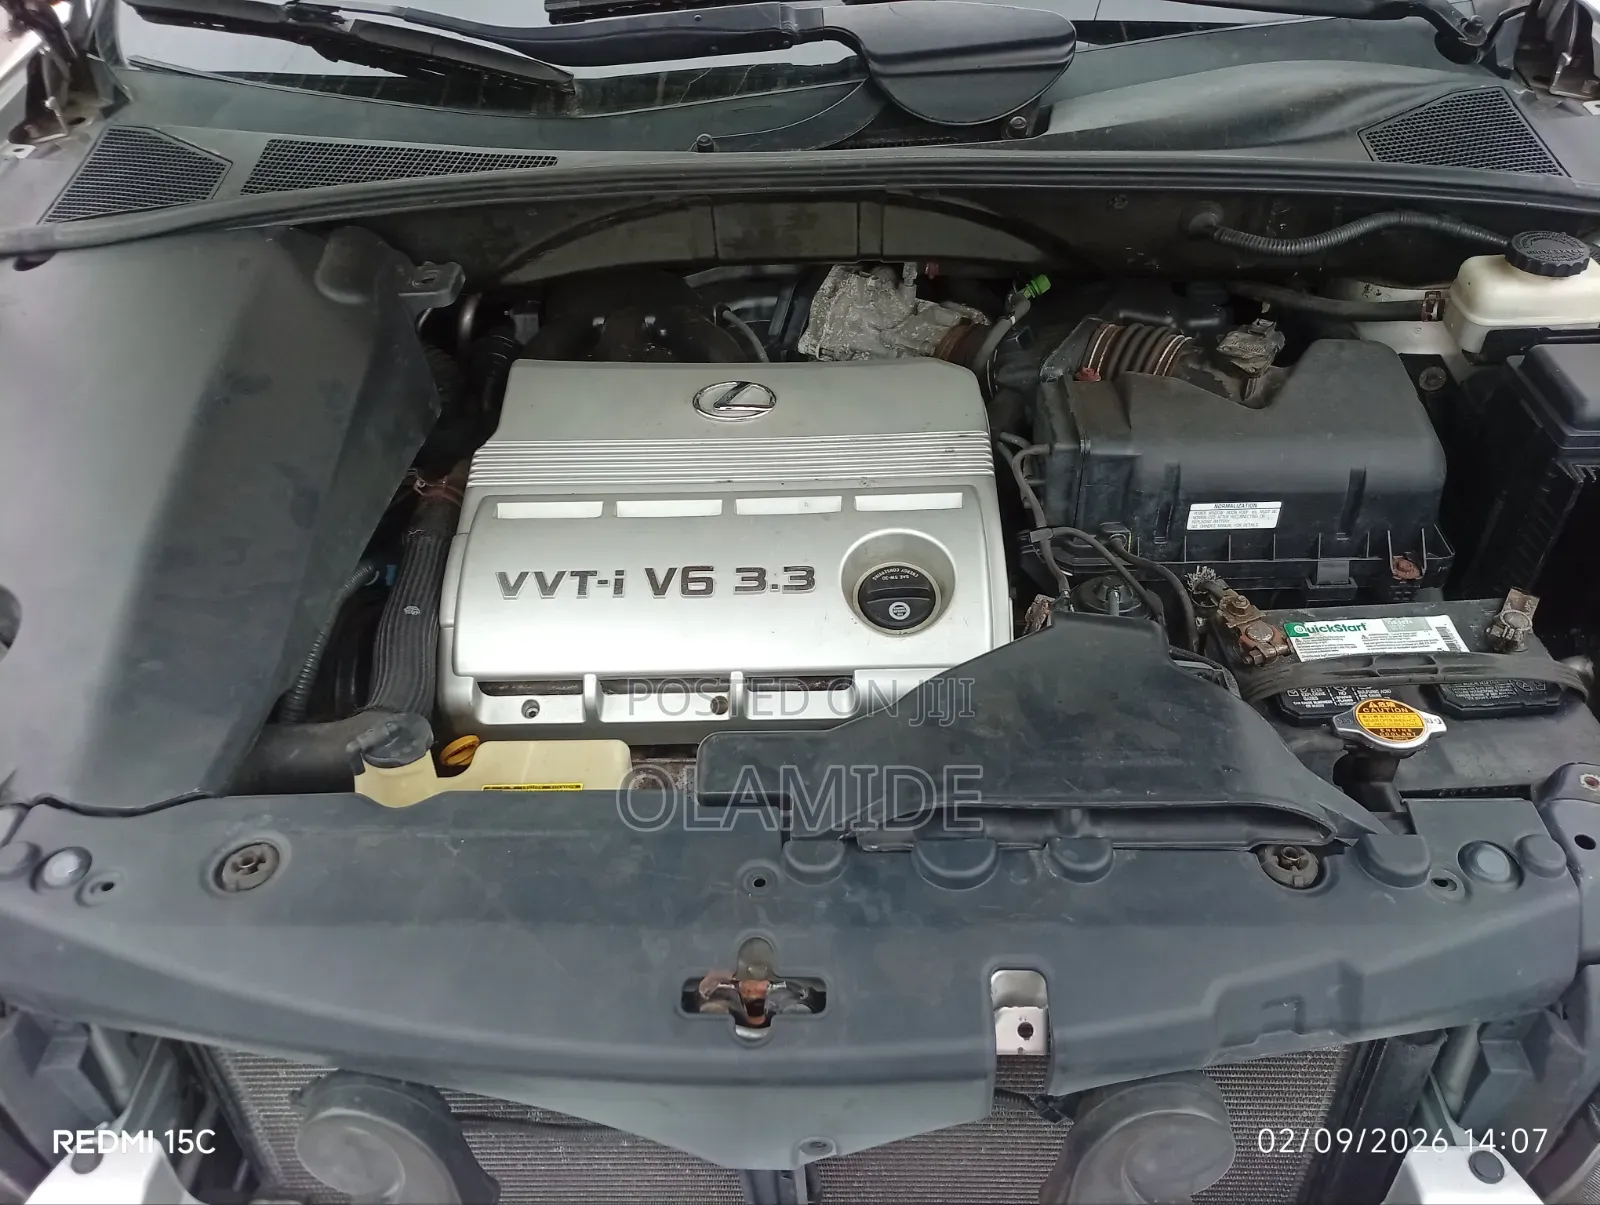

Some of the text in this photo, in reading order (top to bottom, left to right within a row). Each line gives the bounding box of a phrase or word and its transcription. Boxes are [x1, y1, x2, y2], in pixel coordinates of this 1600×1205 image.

[495, 565, 817, 600] VVT-i V6 3.3
[1293, 622, 1367, 635] QuickStart
